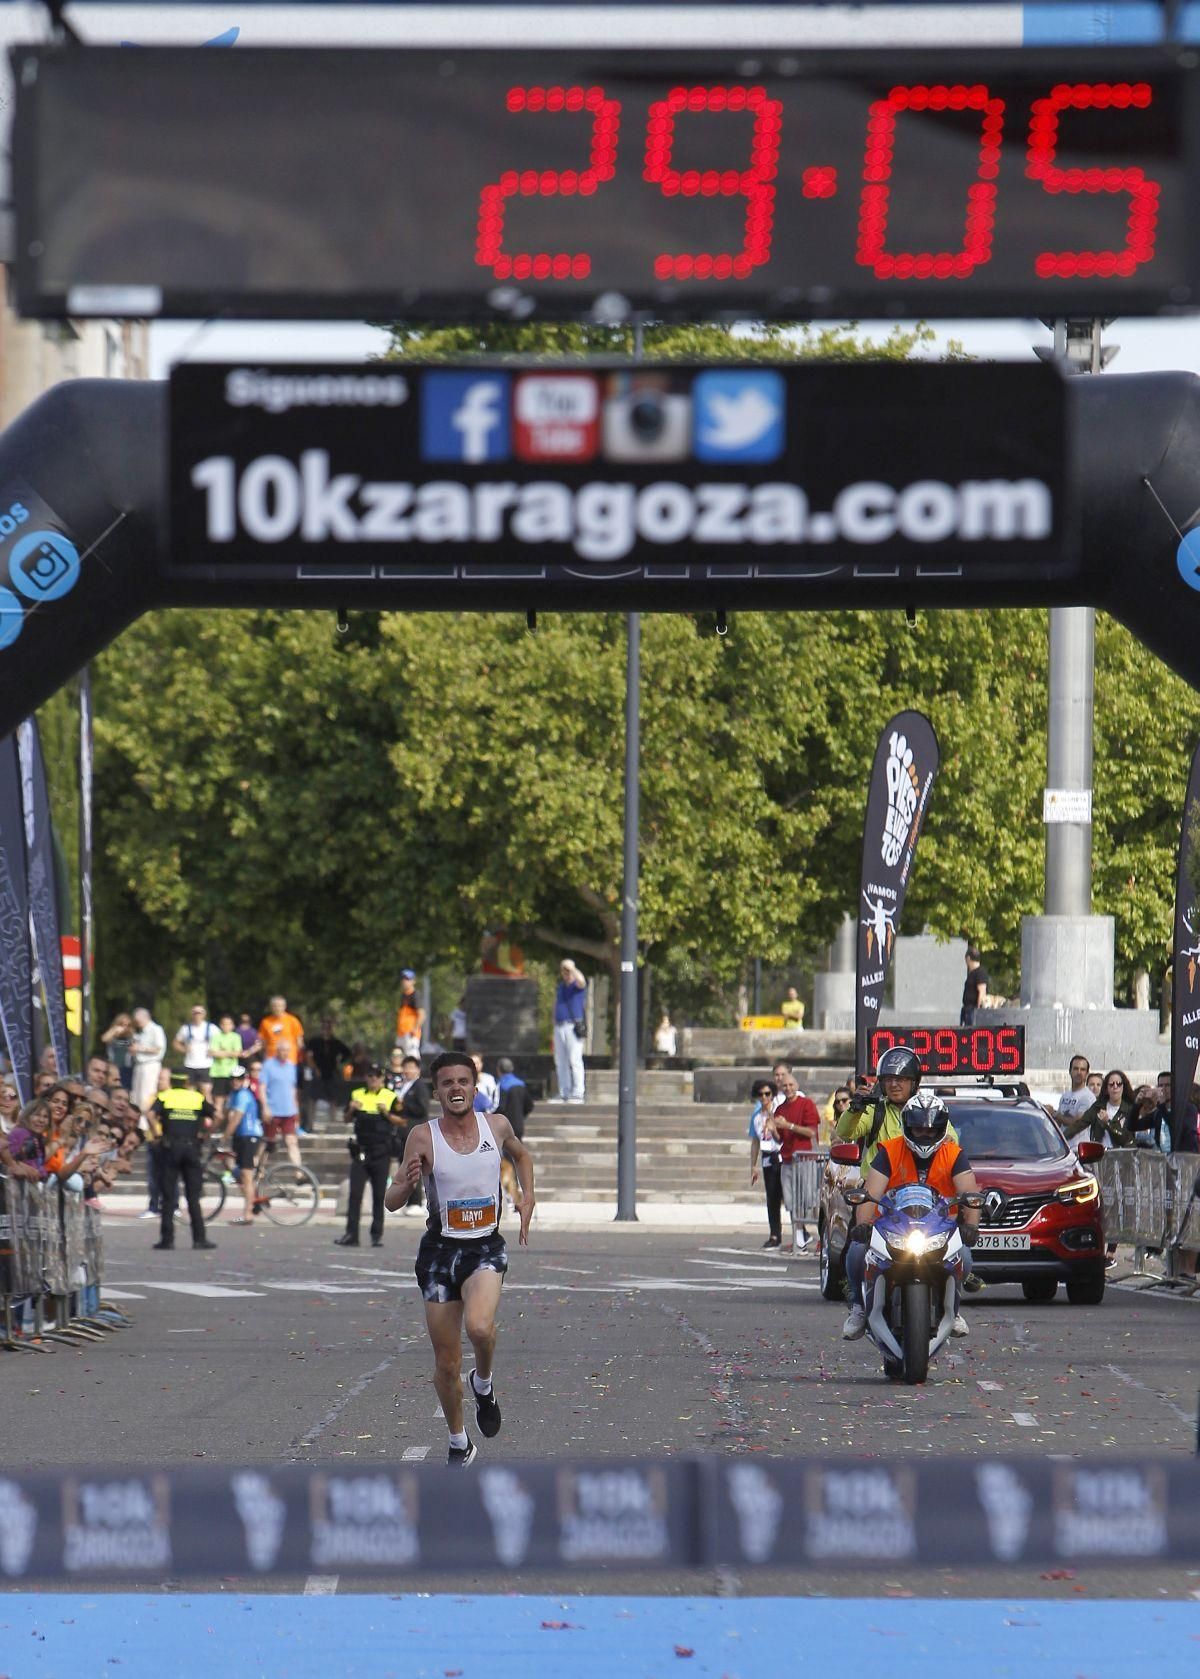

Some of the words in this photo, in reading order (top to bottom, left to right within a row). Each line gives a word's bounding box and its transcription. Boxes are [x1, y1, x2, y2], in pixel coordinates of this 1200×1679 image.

[190, 448, 1051, 561] 10kzaragoza.com
[863, 995, 878, 1010] GO!
[461, 1210, 483, 1222] MAYO
[1004, 1236, 1027, 1248] KSY
